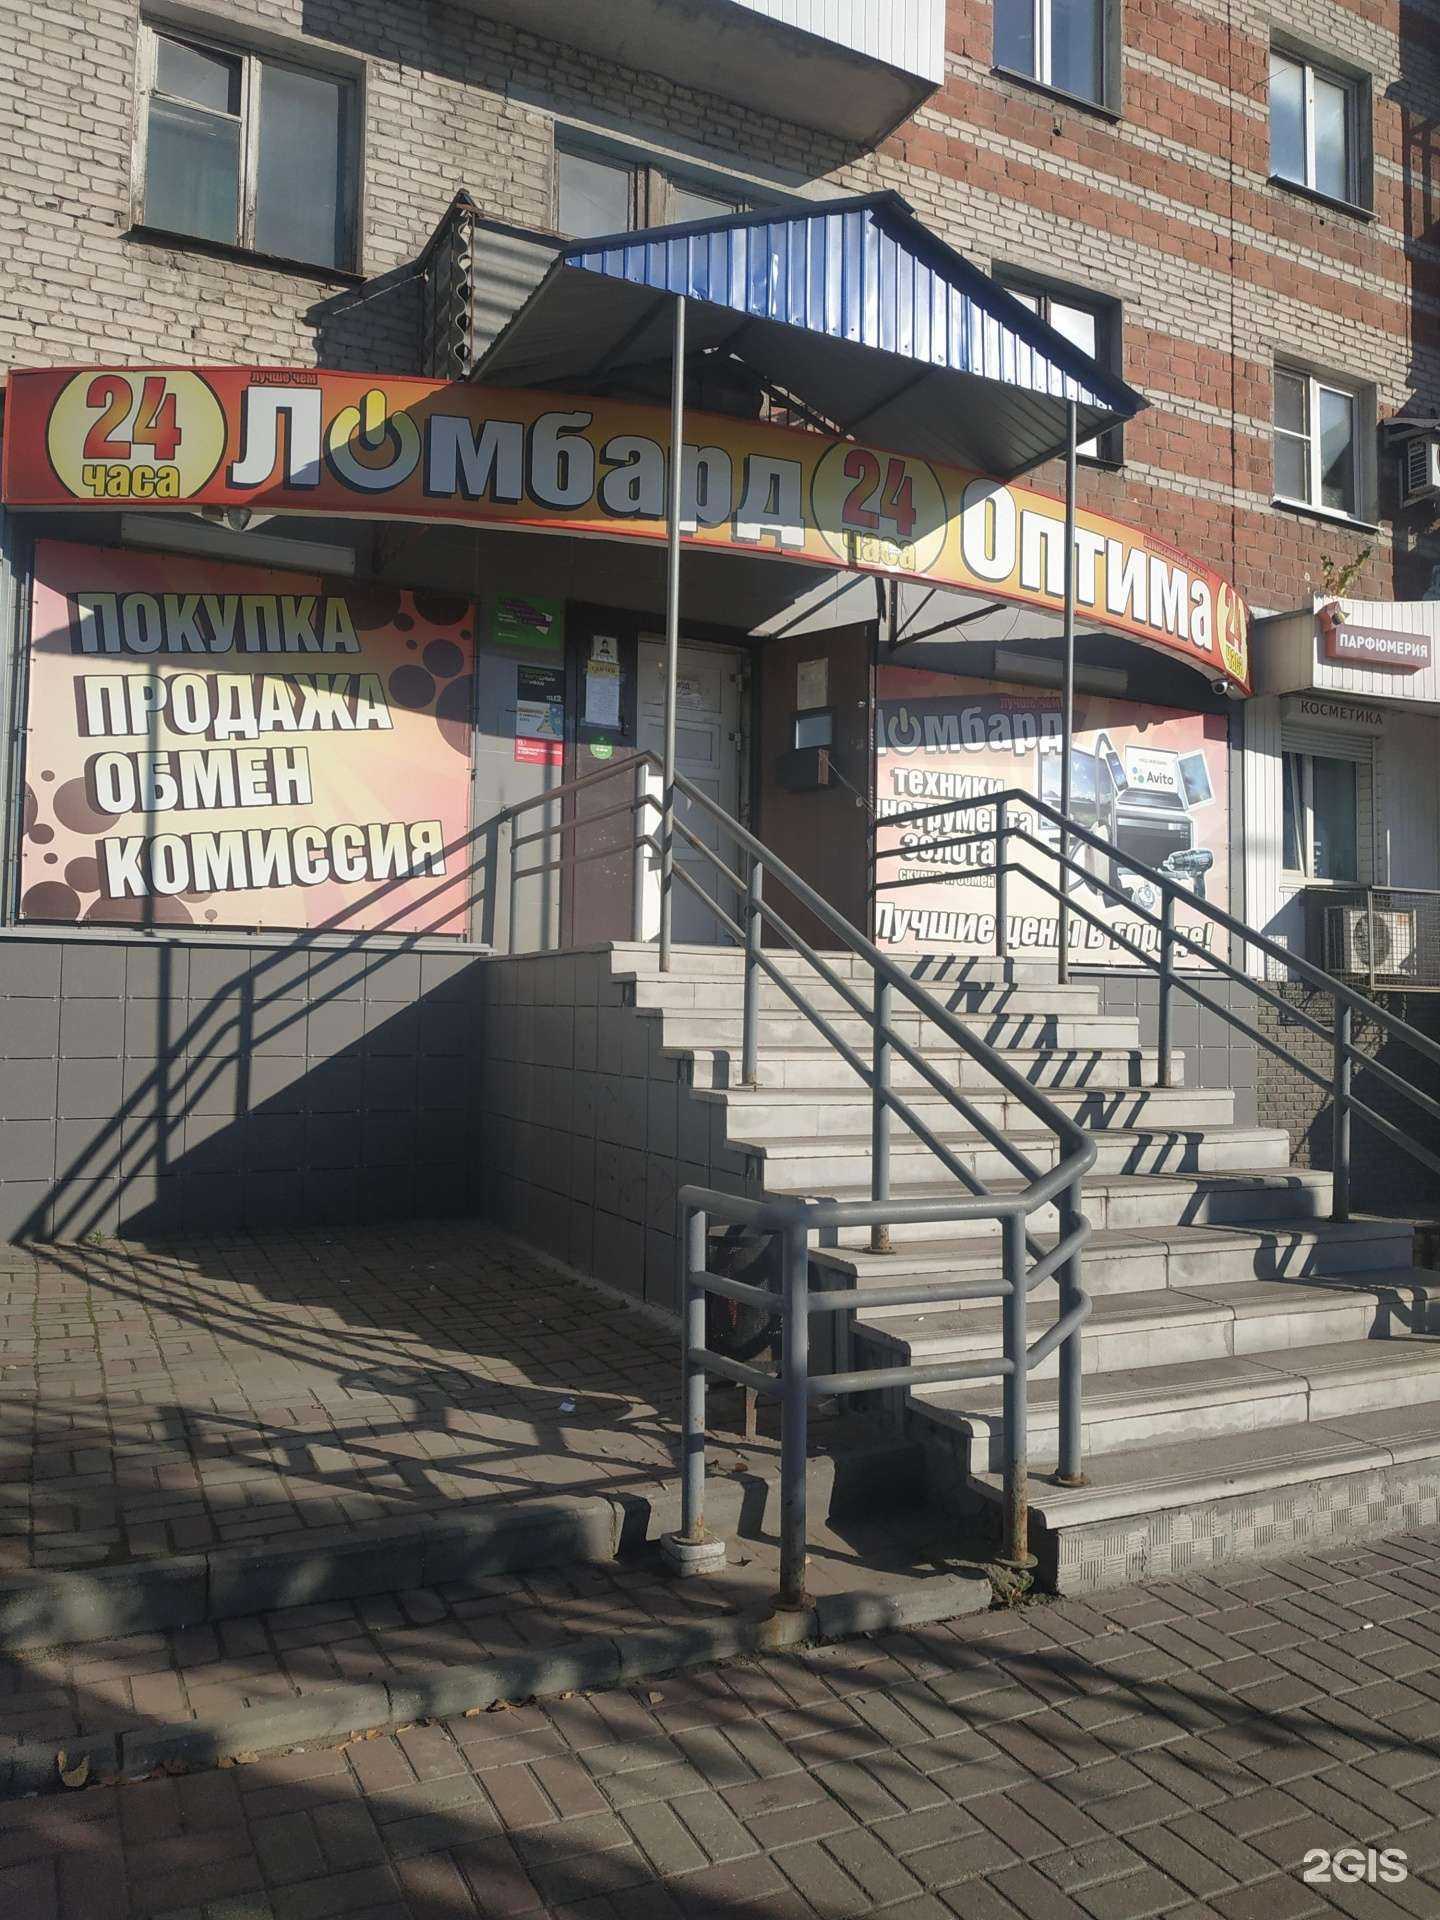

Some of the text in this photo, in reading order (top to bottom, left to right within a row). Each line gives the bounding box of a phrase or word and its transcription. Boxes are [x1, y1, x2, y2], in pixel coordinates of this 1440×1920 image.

[291, 371, 318, 385] чем
[81, 374, 182, 461] 24
[81, 464, 182, 498] часа
[842, 447, 917, 537] 24
[842, 528, 917, 572] часа
[961, 477, 1213, 652] Оптима
[68, 591, 362, 655] ПОКУПКА
[1339, 632, 1429, 658] ПАРФЮМЕРИЯ
[75, 672, 394, 741] ПРОДАЖА
[1300, 700, 1384, 726] КОСМЕТИКА
[84, 745, 314, 815] ОБМЕН
[890, 766, 1007, 801] техники
[1146, 770, 1174, 785] Avito
[96, 819, 448, 900] КОМИССИЯ
[875, 901, 996, 944] Лучшие
[1084, 922, 1105, 949] в
